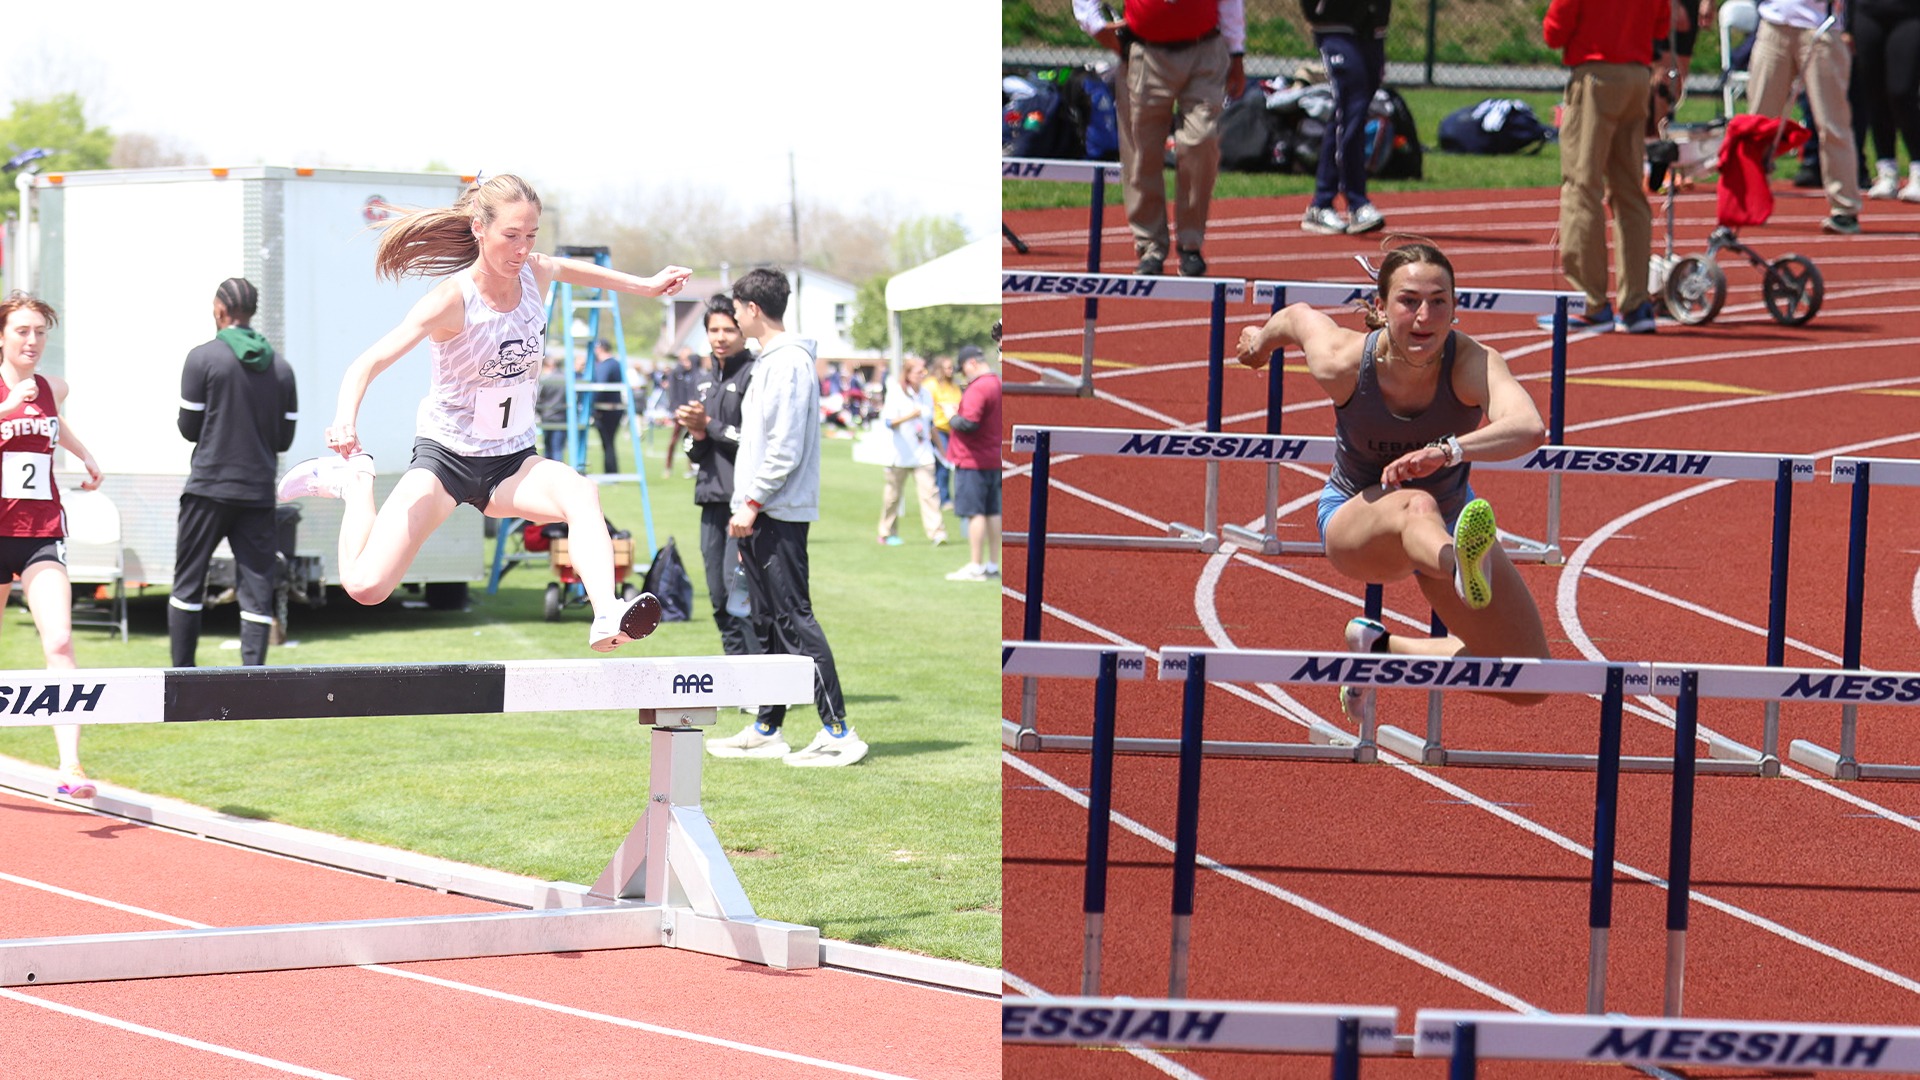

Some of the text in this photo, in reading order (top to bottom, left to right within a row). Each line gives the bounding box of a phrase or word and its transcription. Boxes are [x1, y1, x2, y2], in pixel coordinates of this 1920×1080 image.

[1002, 274, 1158, 297] MESSIAH
[498, 397, 512, 429] 1
[1118, 433, 1308, 460] MESSIAH
[22, 463, 36, 490] 2
[1523, 449, 1712, 475] MESSIAH
[1289, 656, 1524, 688] MESSIAH
[1781, 673, 1920, 702] MESS
[1002, 1006, 1227, 1043] ESSIAH
[1588, 1027, 1893, 1068] MESSIAH
